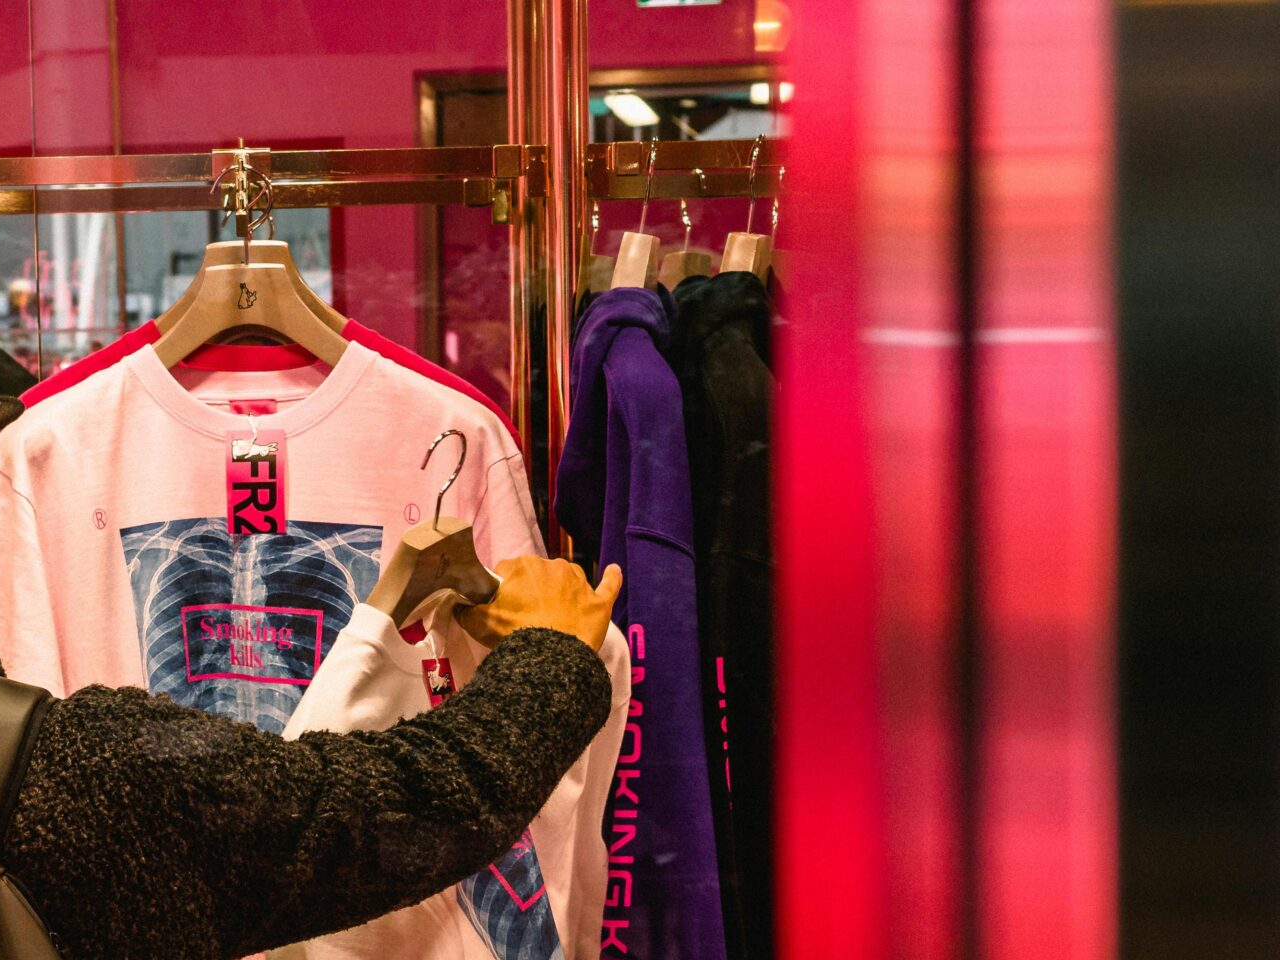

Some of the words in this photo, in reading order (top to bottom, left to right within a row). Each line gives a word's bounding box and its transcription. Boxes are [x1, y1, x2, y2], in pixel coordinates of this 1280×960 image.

[232, 454, 278, 534] FR2
[200, 617, 293, 650] Smoking
[230, 643, 265, 670] kills
